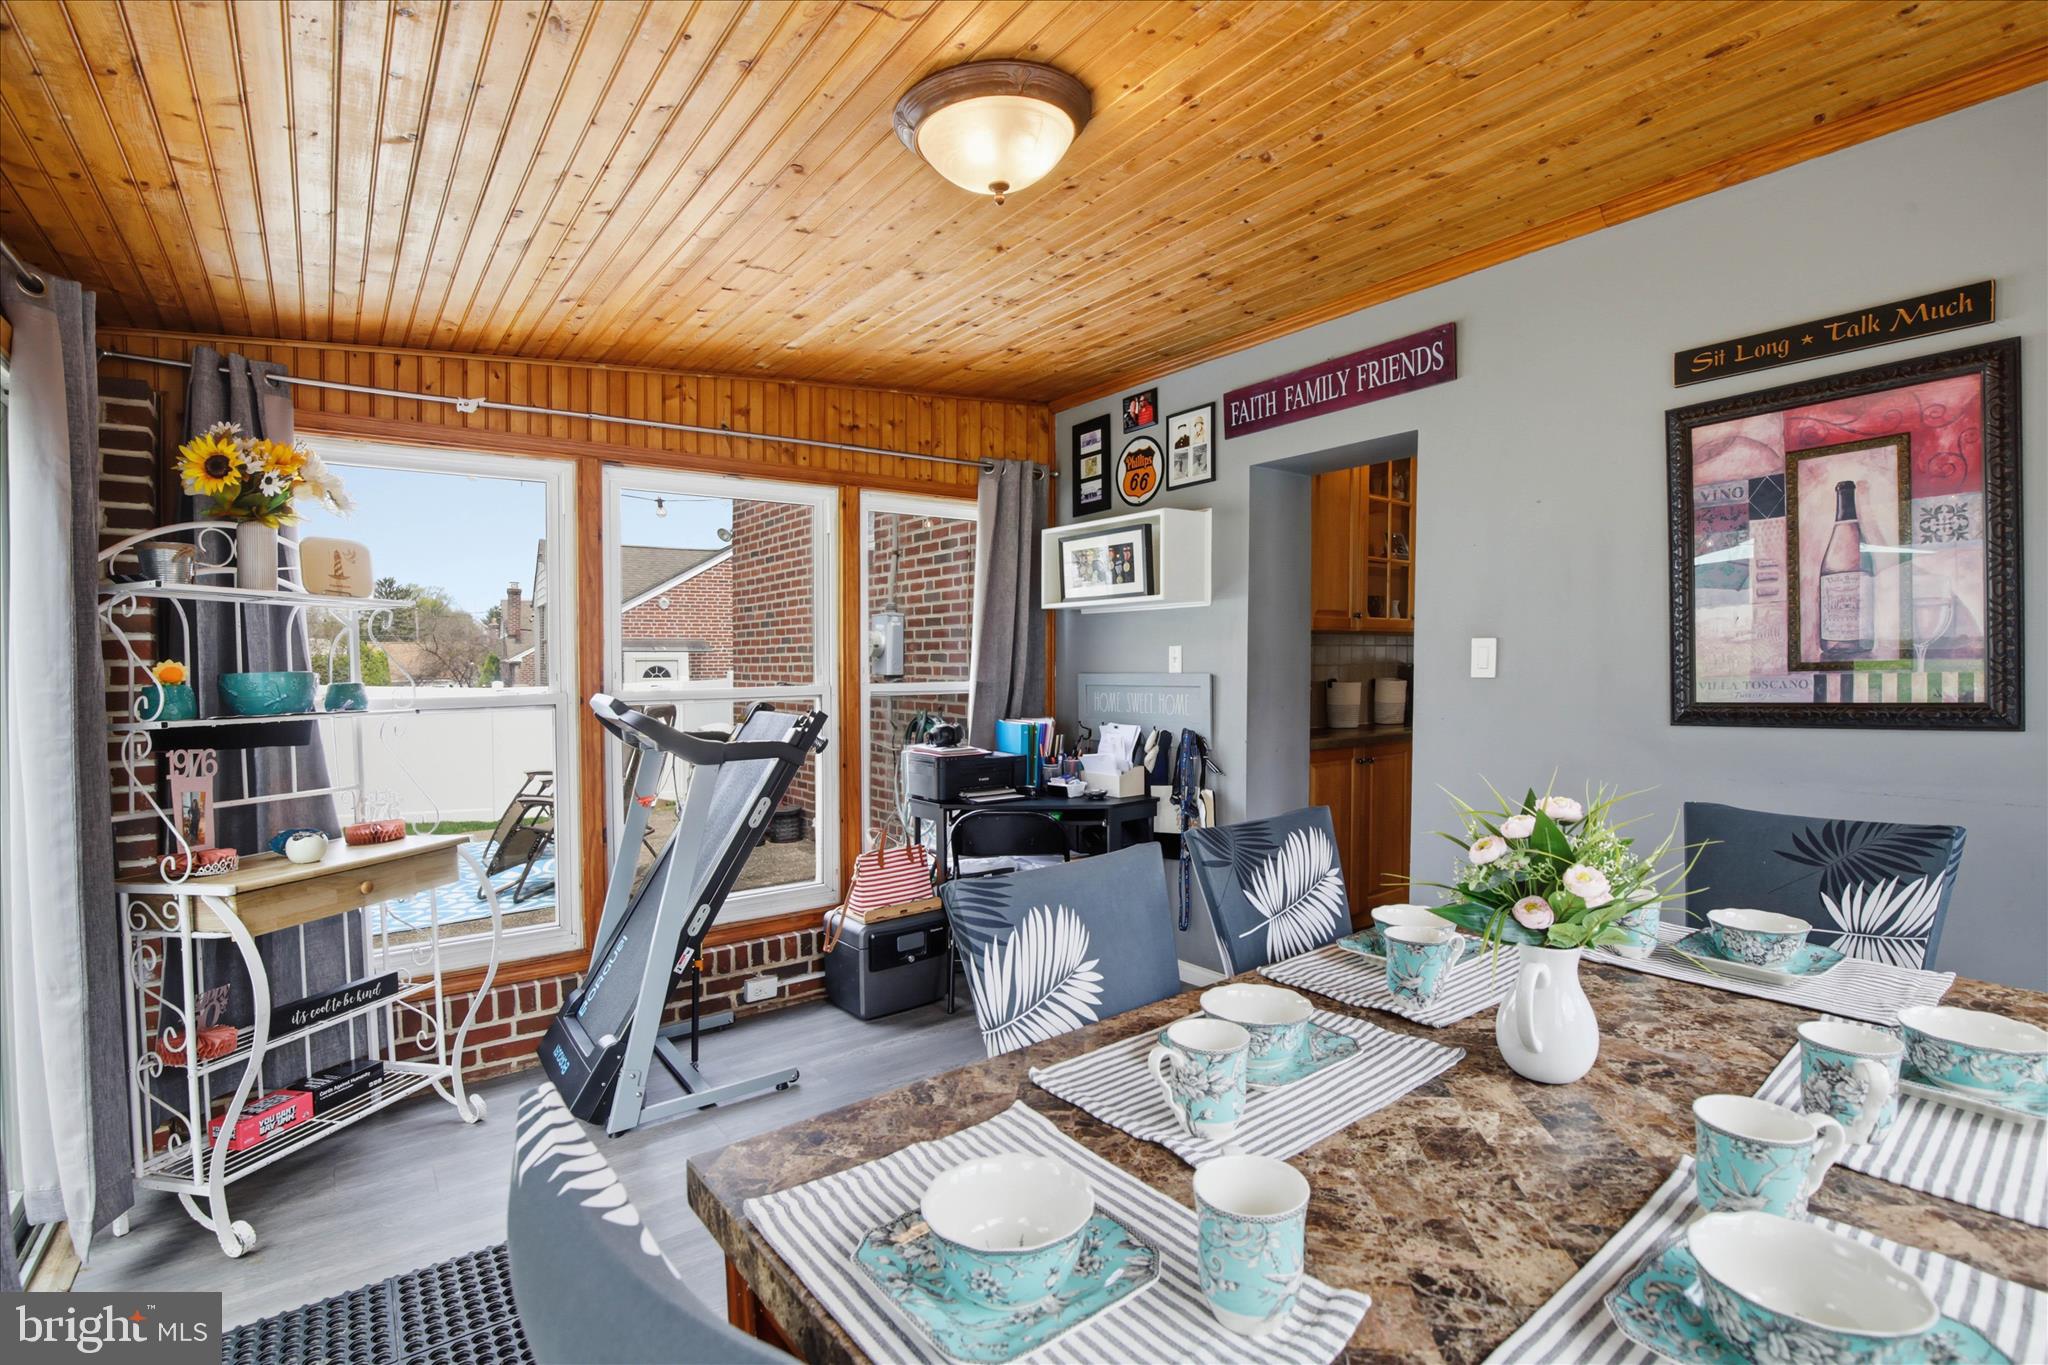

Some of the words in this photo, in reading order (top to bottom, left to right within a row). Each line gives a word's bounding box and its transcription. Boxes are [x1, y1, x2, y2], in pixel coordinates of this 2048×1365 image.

[1690, 349, 1726, 373] Sit
[1734, 337, 1790, 362] Long
[1823, 313, 1881, 342] Talk
[1889, 292, 1974, 332] Much
[1230, 390, 1278, 427] FAITH
[1283, 368, 1351, 413] FAMILY
[1356, 340, 1445, 392] FRIENDS
[1130, 472, 1150, 491] 66
[1700, 486, 1745, 502] VINO
[1742, 679, 1810, 691] TOSCANO
[1093, 691, 1122, 713] HOME
[1126, 692, 1154, 714] SWEET
[1158, 693, 1191, 716] HOME
[165, 748, 219, 780] 1976
[310, 999, 332, 1018] cool
[332, 997, 342, 1012] to
[343, 992, 356, 1006] be
[356, 982, 382, 1002] kind
